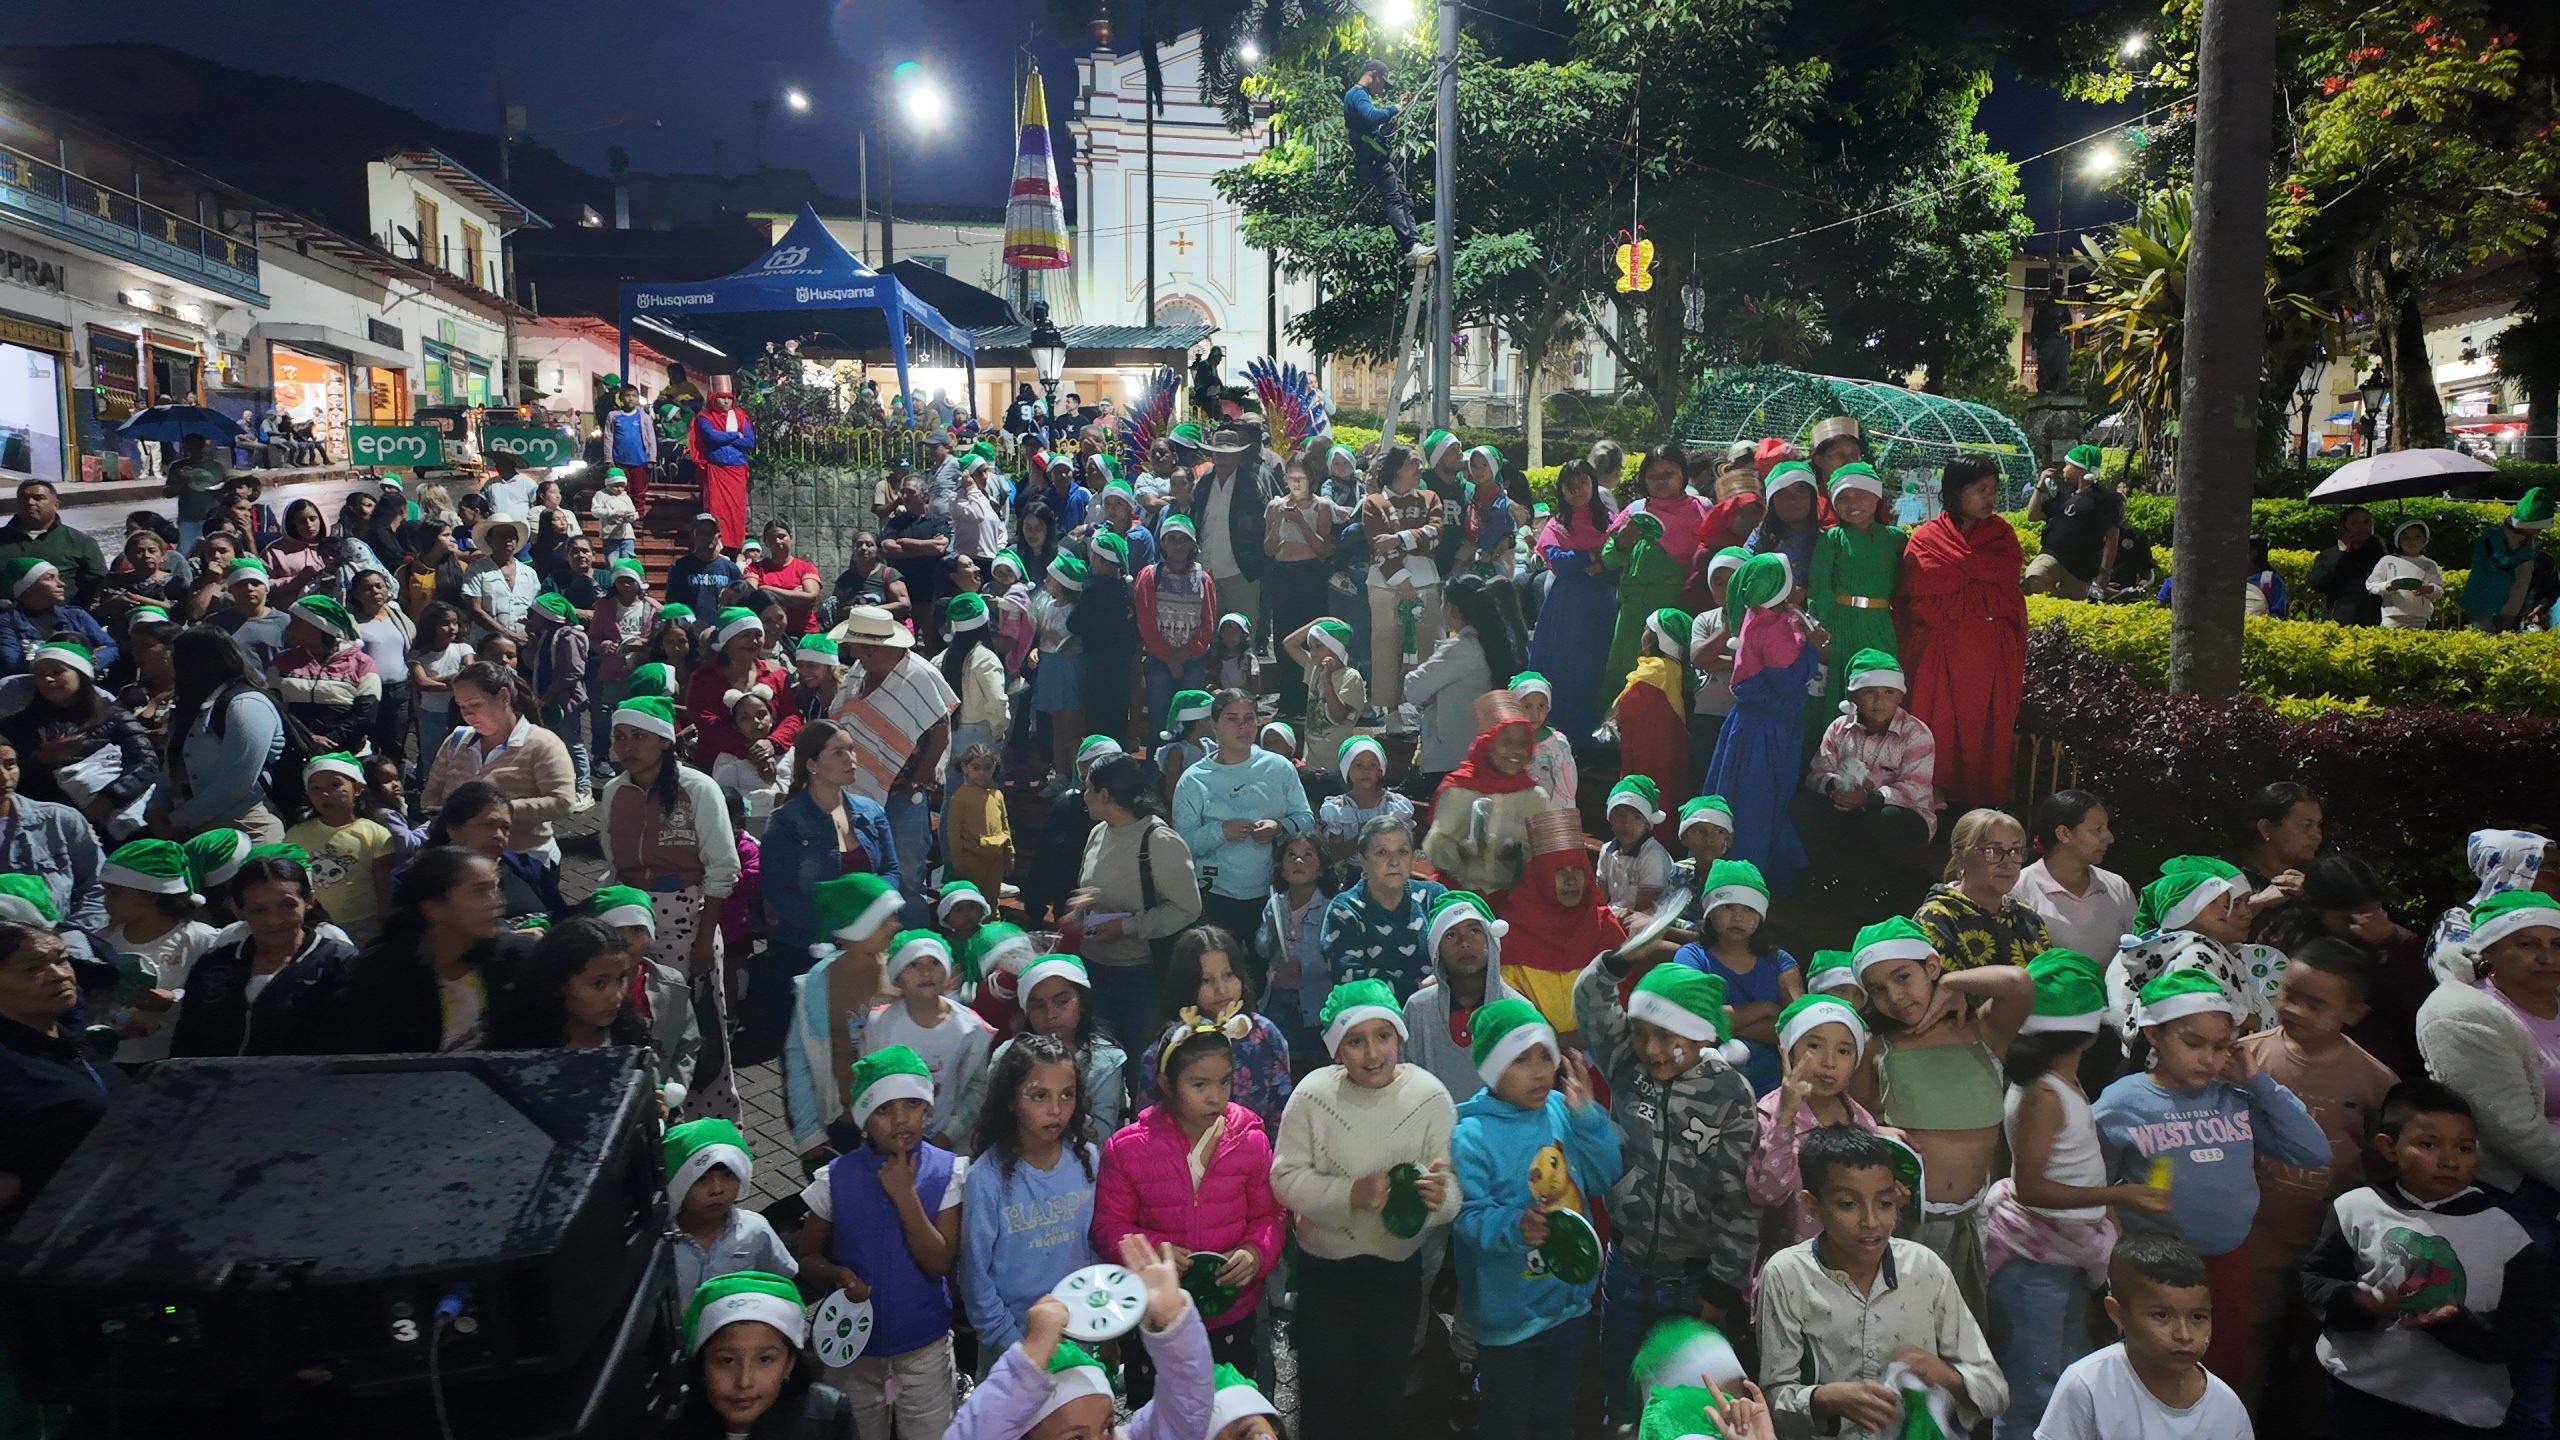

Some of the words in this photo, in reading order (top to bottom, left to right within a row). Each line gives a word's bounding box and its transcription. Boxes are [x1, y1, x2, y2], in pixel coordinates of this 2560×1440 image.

[651, 293, 714, 307] Husqvarna
[810, 287, 875, 302] Husqvarna
[1020, 405, 1032, 421] 9
[357, 435, 427, 462] epm
[1453, 906, 1473, 916] epm
[2509, 911, 2537, 922] epm
[1819, 1007, 1843, 1015] epm
[1633, 1073, 1656, 1097] FOX
[1639, 1104, 1657, 1120] 23
[2163, 1108, 2220, 1120] CALIFORNIA
[2127, 1121, 2196, 1158] WEST
[2195, 1110, 2253, 1145] COAS
[2193, 1150, 2222, 1160] 1992
[727, 1298, 762, 1310] epm
[392, 1319, 420, 1342] 3
